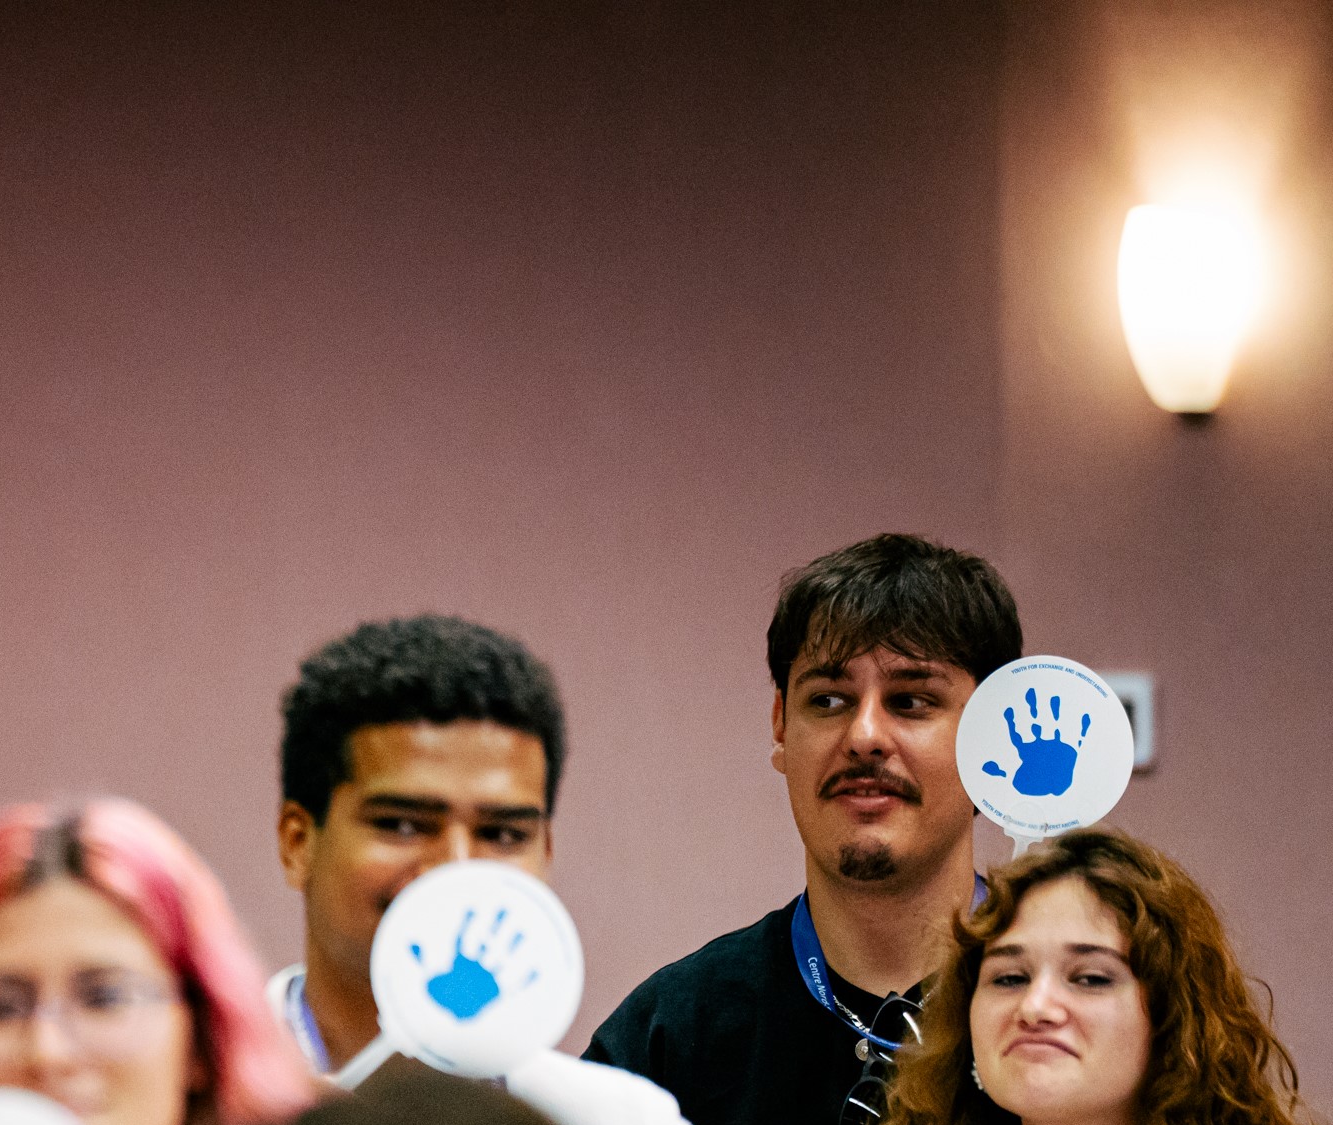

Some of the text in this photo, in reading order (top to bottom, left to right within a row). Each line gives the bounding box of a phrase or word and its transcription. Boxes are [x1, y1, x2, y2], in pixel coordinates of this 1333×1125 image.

[1011, 666, 1027, 675] YOUTH
[1038, 663, 1064, 671] EXCHANGE
[1065, 667, 1076, 675] AND
[1075, 671, 1109, 699] UNDERSTANDING
[808, 956, 822, 985] Centre
